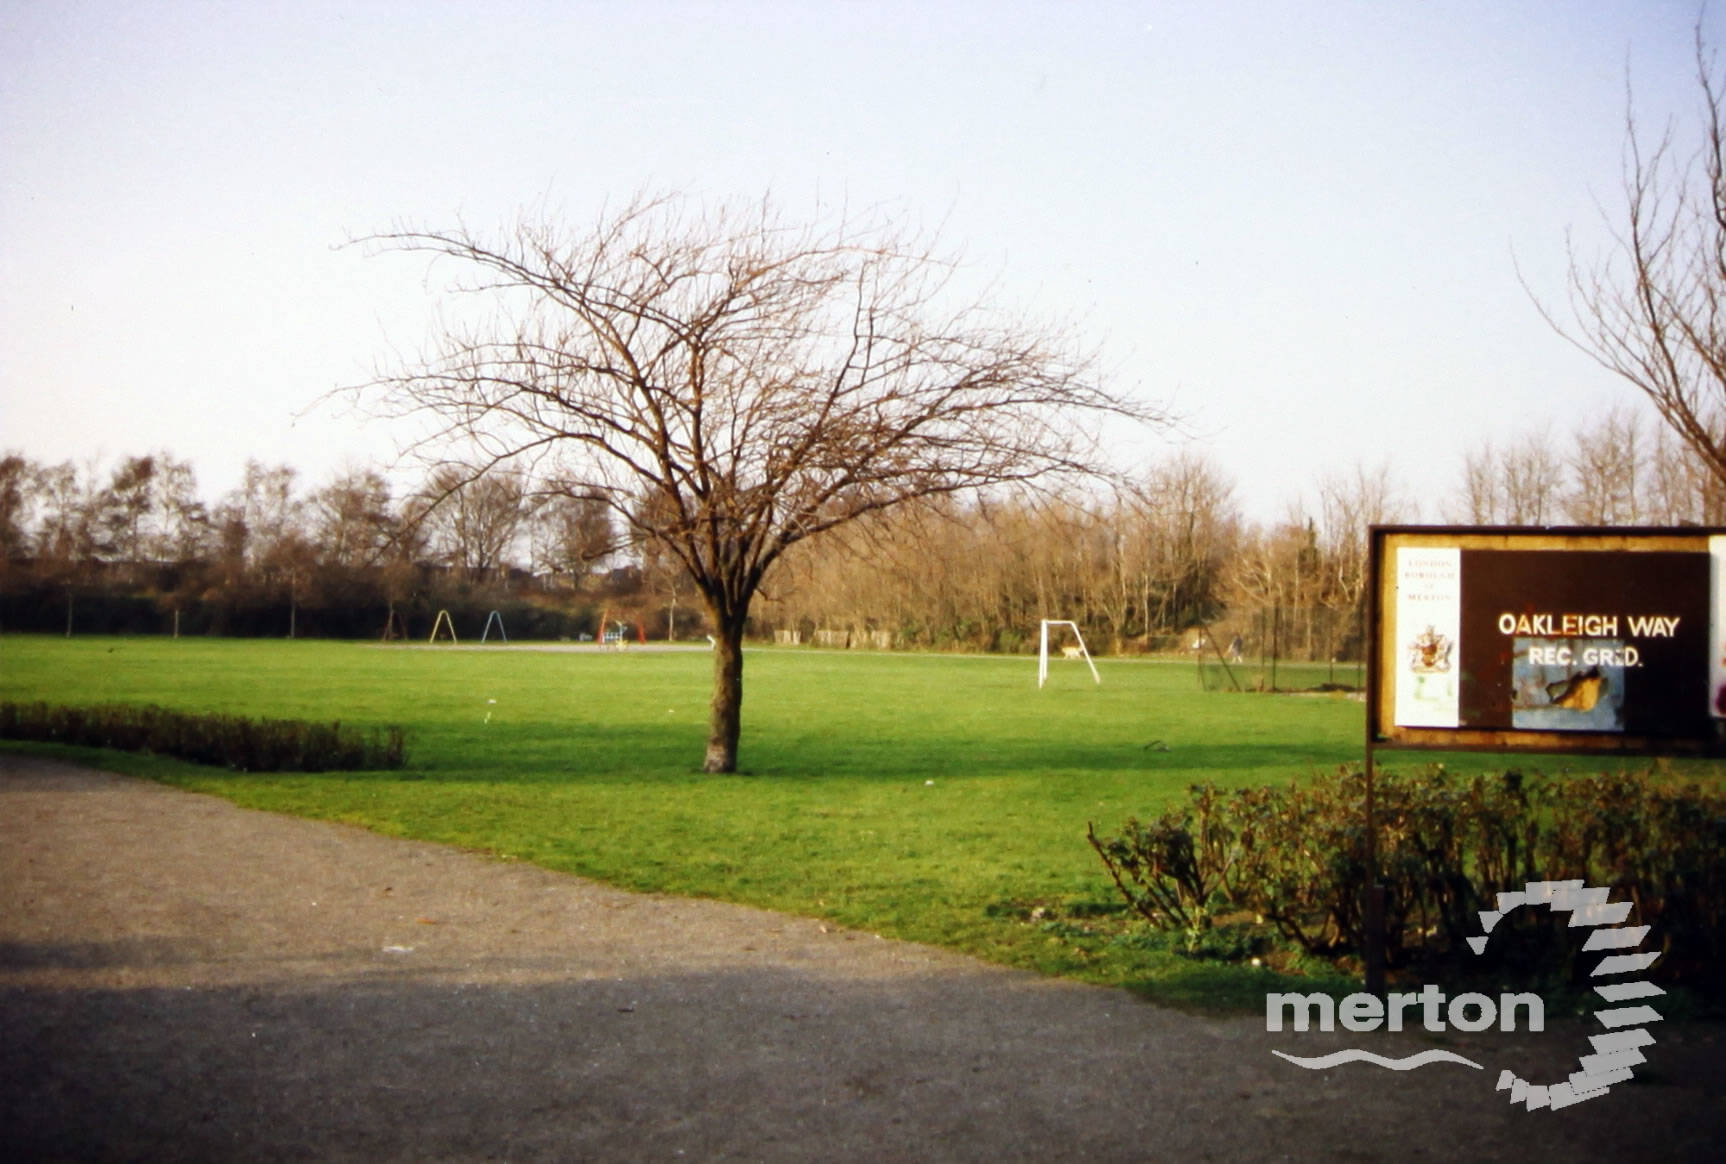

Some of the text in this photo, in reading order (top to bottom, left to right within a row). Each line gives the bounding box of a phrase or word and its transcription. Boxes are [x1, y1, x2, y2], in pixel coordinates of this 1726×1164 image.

[1498, 613, 1680, 638] OAKLEIGH WAY
[1528, 646, 1577, 666] REC.
